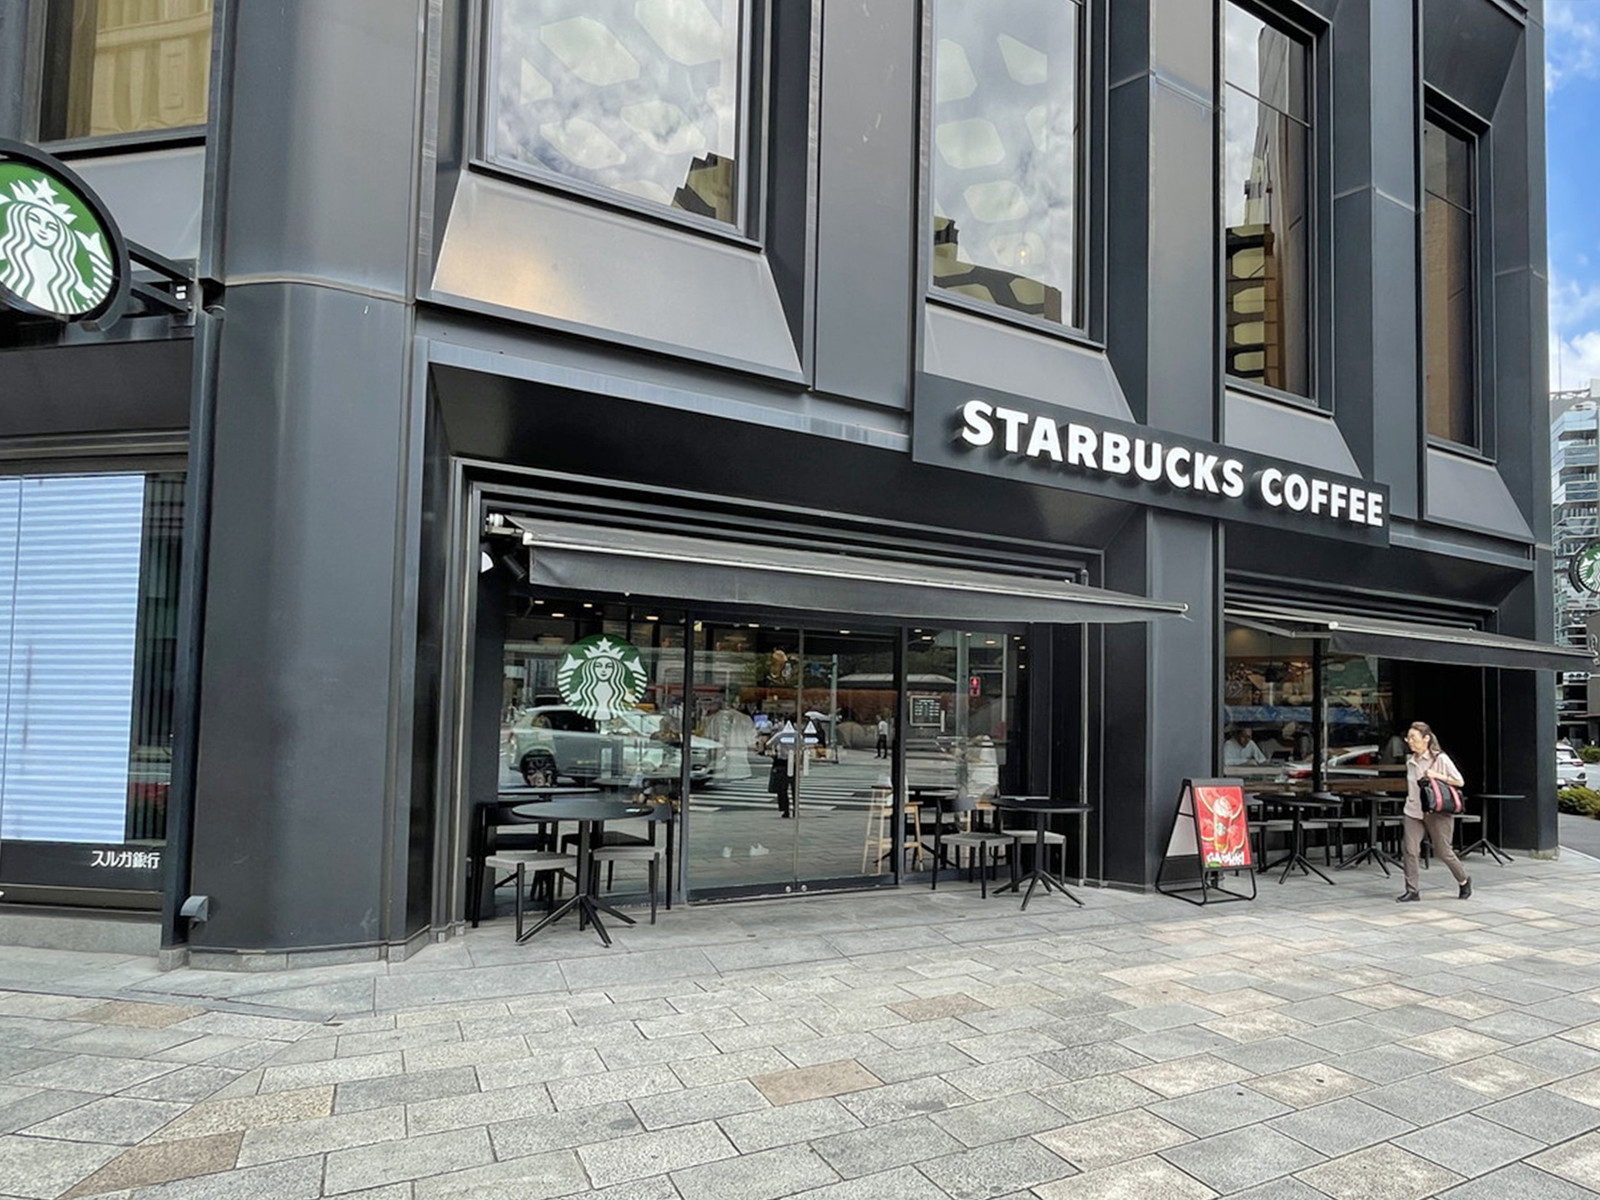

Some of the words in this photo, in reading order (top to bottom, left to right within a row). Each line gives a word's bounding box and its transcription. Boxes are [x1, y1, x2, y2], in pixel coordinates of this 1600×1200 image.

[961, 400, 1244, 497] STARBUCKS
[1260, 467, 1384, 527] COFFEE
[90, 850, 161, 869] スルガ銀行
